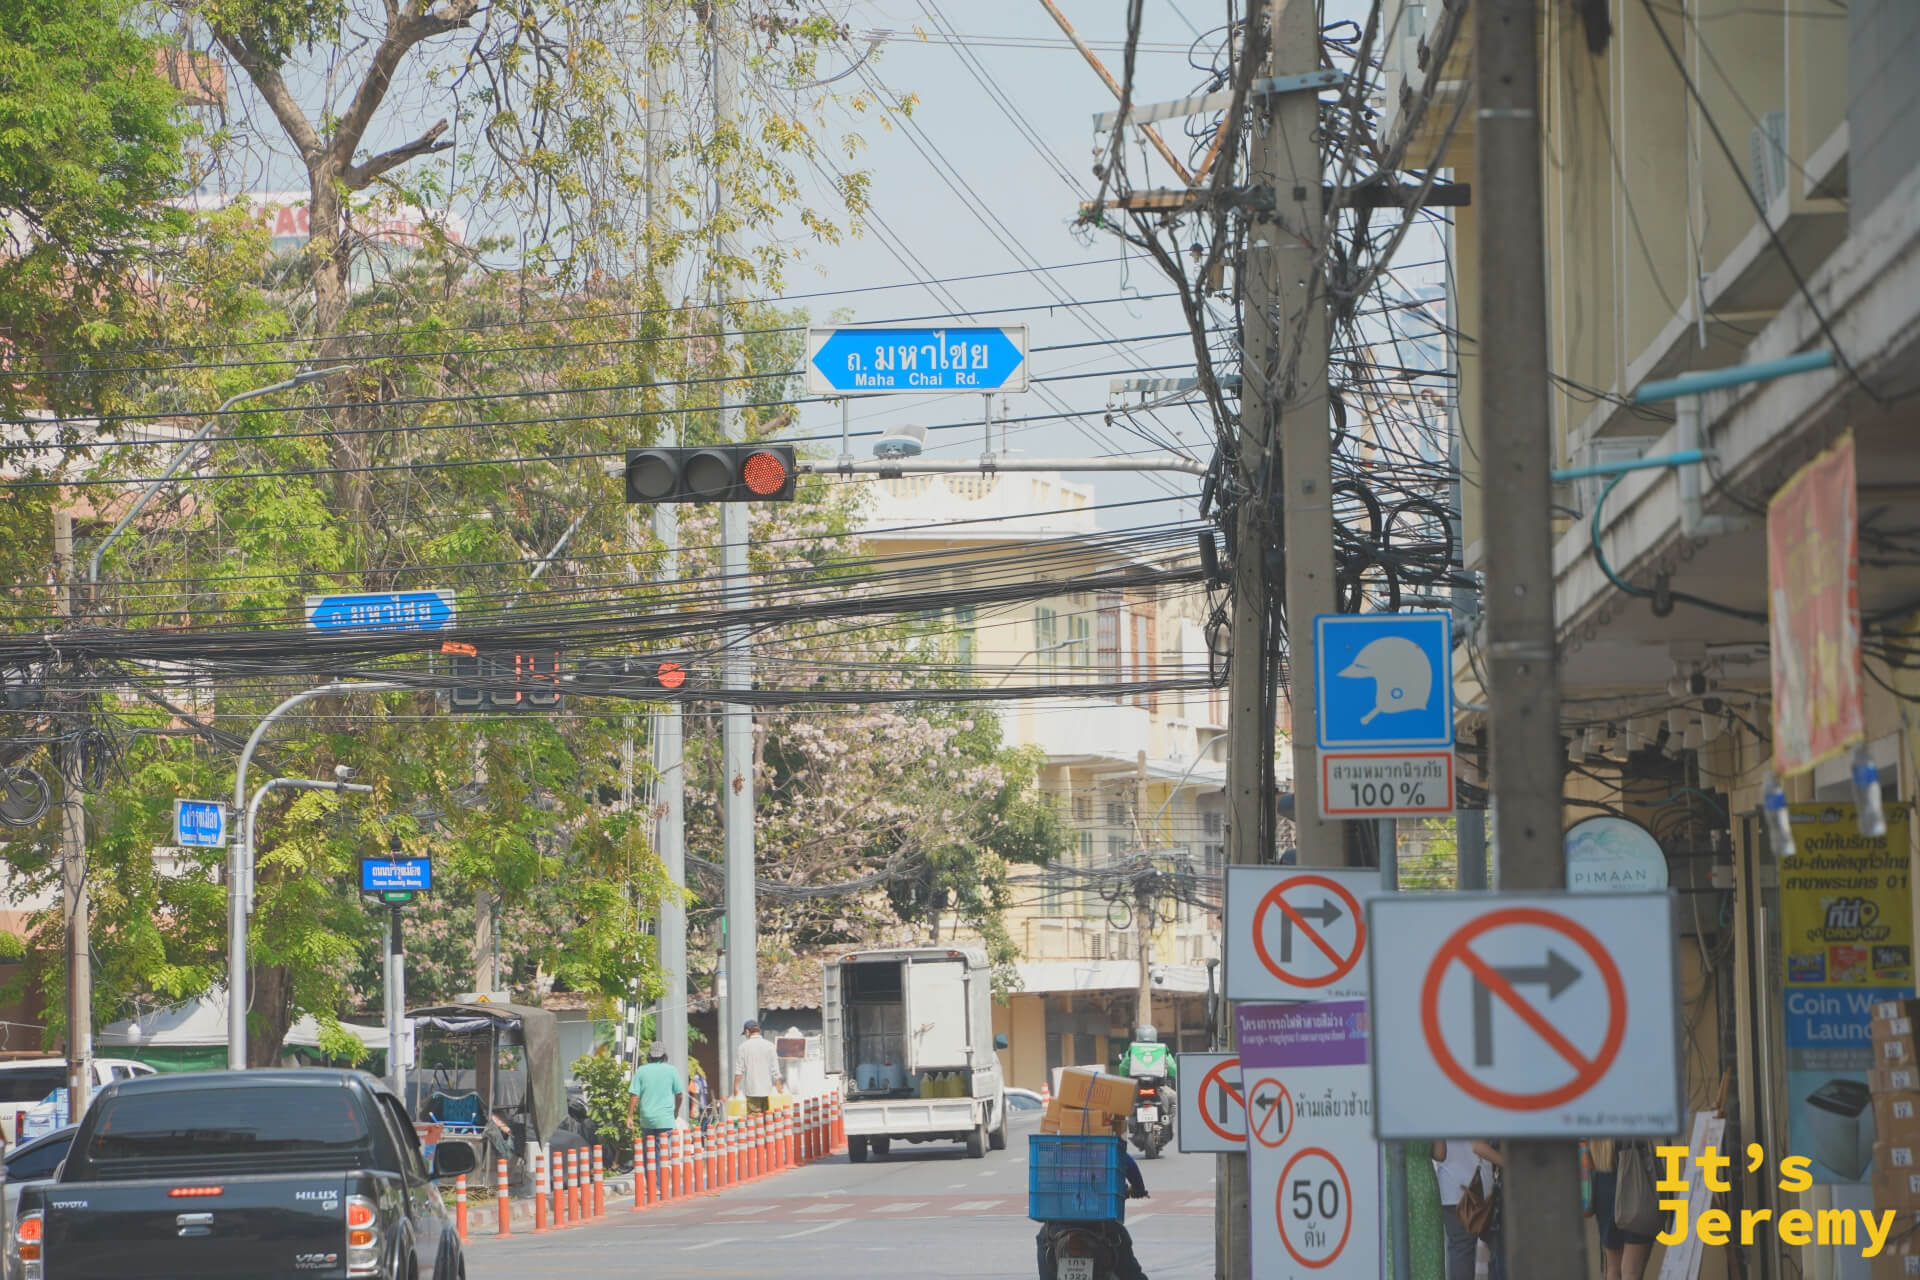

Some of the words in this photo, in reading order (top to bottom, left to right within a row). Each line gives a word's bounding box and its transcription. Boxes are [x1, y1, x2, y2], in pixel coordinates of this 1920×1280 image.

[847, 352, 867, 371] ถ.
[875, 331, 988, 371] มหาไชย
[855, 373, 895, 386] Maha
[908, 372, 943, 386] Chai
[955, 372, 980, 385] Rd.
[1333, 760, 1442, 780] สวมหมวกนิรภัย
[1575, 869, 1647, 884] PIMAAN
[1789, 991, 1841, 1015] Coin
[52, 1200, 88, 1208] TOYOTA
[296, 1190, 338, 1200] HILUX
[1293, 1179, 1339, 1220] 50
[1304, 1221, 1326, 1248] ตัน
